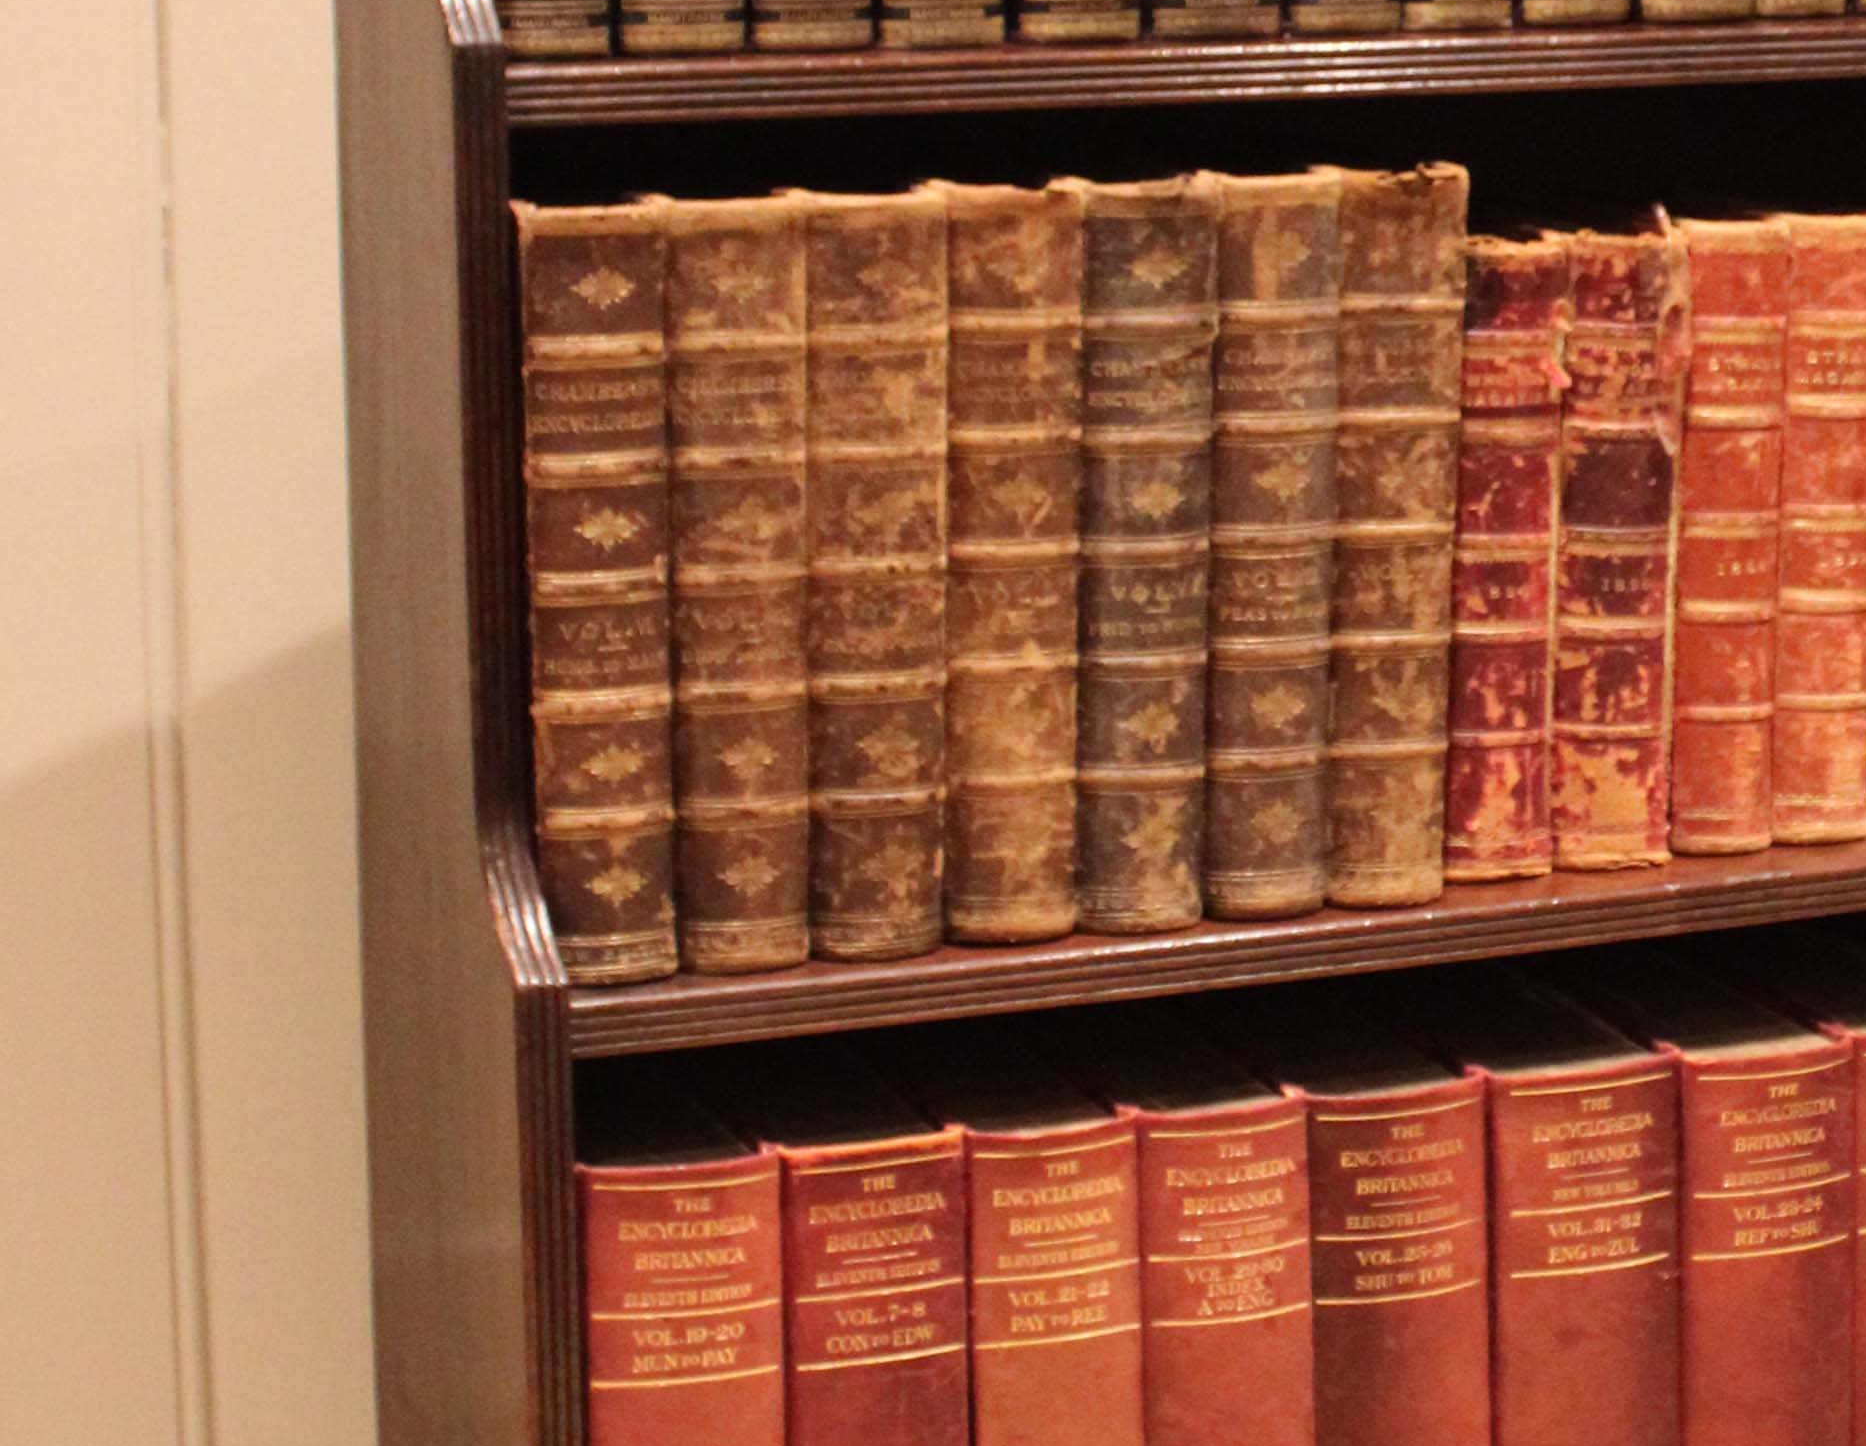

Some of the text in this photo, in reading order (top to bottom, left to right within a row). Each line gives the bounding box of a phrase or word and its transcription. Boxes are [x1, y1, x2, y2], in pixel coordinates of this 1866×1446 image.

[1768, 1083, 1799, 1099] THE
[1580, 1096, 1613, 1113] THE
[1391, 1123, 1424, 1140] THE
[1734, 1126, 1826, 1153] BRITANNICA
[1218, 1143, 1252, 1159] THE
[1547, 1142, 1641, 1170] BRITANNICA
[1046, 1160, 1081, 1177] THE
[862, 1174, 896, 1193] THE
[1356, 1169, 1453, 1195] BRITANNICA
[674, 1198, 711, 1213] THE
[1182, 1187, 1283, 1216] BRITANNICA
[1008, 1207, 1112, 1236] BRITANNICA
[826, 1224, 934, 1253] BRITANNICA
[1734, 1227, 1769, 1246] REF
[635, 1247, 746, 1271] BRITANNICA
[1548, 1236, 1640, 1264] ENG ZUL
[888, 1301, 926, 1322] 7-8
[686, 1322, 745, 1343] 19-20
[1010, 1314, 1045, 1333] PAY
[826, 1323, 935, 1353] CON EDW
[702, 1348, 736, 1368] PAY
